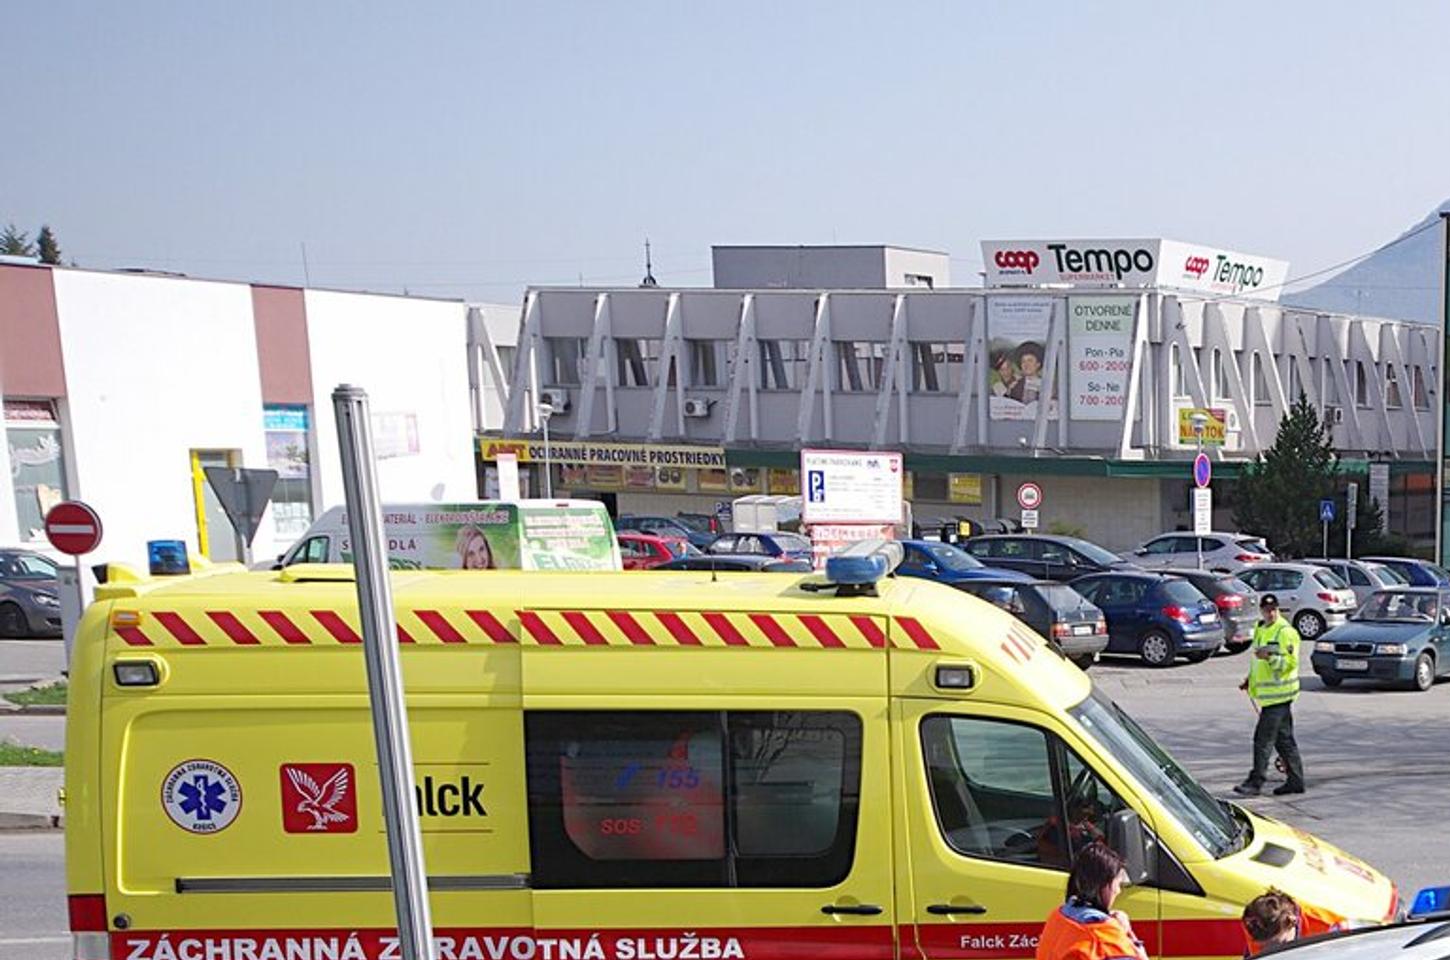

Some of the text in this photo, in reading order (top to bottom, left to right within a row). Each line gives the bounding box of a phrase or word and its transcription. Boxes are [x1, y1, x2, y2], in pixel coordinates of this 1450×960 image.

[1047, 244, 1154, 280] Tempo
[1213, 255, 1263, 292] Tempo
[1075, 303, 1132, 316] OTVORENÉ
[590, 446, 647, 463] PRACOVNÉ
[650, 450, 727, 467] PROSTRIEDKY
[413, 776, 488, 817] lck
[615, 931, 745, 960] SLUŽBA
[960, 934, 1005, 950] Falck
